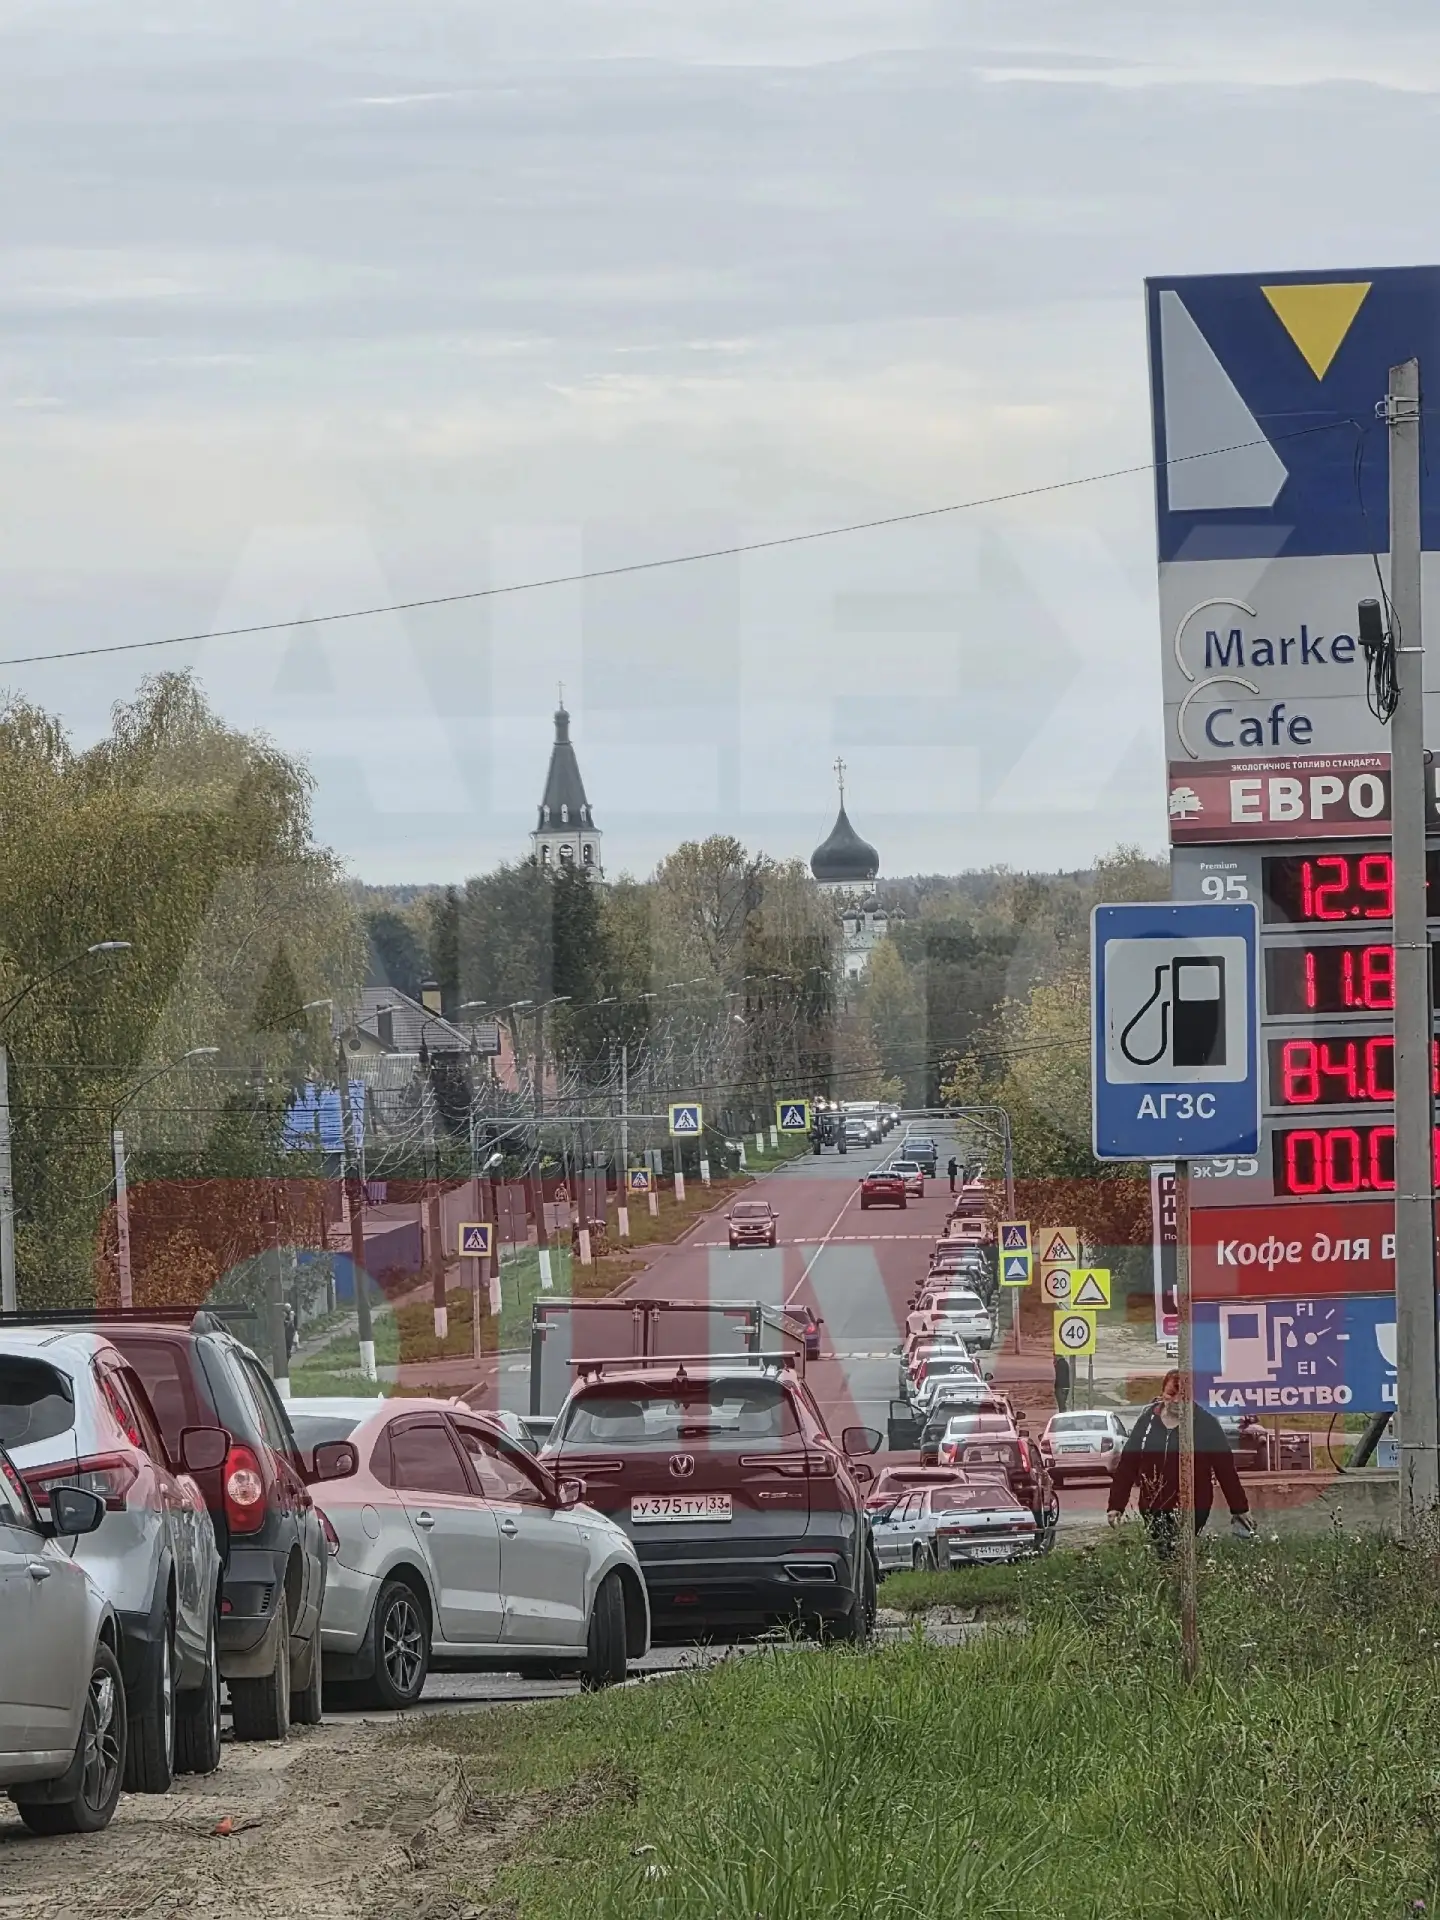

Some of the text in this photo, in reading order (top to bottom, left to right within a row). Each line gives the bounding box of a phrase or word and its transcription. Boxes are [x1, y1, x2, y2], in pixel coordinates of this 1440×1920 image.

[1204, 625, 1356, 669] Marke
[1205, 703, 1313, 747] Cafe
[1231, 758, 1382, 772] ЭКОЛОГИЧНОЕ ТОПЛИВО СТАНДАРТА
[1229, 773, 1385, 823] ЕВРО
[1200, 861, 1238, 871] Premium
[1201, 875, 1248, 900] 95
[1136, 1093, 1217, 1120] АГЗС
[1217, 1235, 1303, 1272] Кофе
[1311, 1232, 1370, 1262] для
[1052, 1278, 1067, 1289] 20
[1065, 1325, 1085, 1339] 40
[1208, 1385, 1353, 1409] КАЧЕСТВО
[709, 1497, 725, 1510] 33
